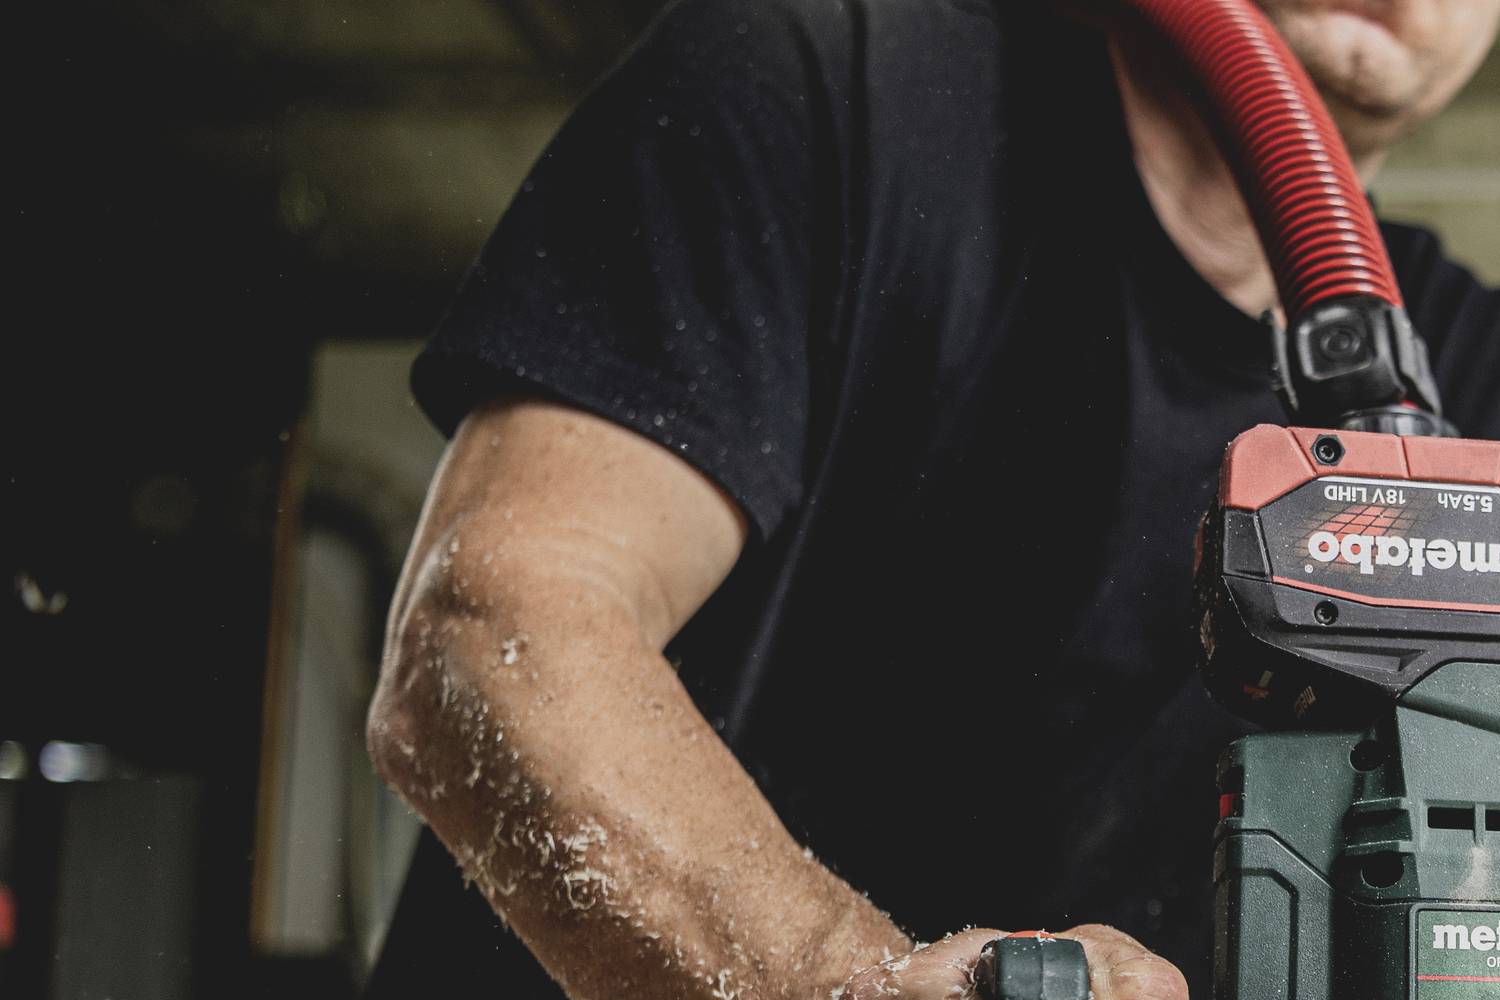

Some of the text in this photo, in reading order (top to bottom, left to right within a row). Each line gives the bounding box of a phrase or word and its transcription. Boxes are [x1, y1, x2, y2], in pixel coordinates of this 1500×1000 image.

[1324, 484, 1493, 513] 5.5Ah 18V LiHD
